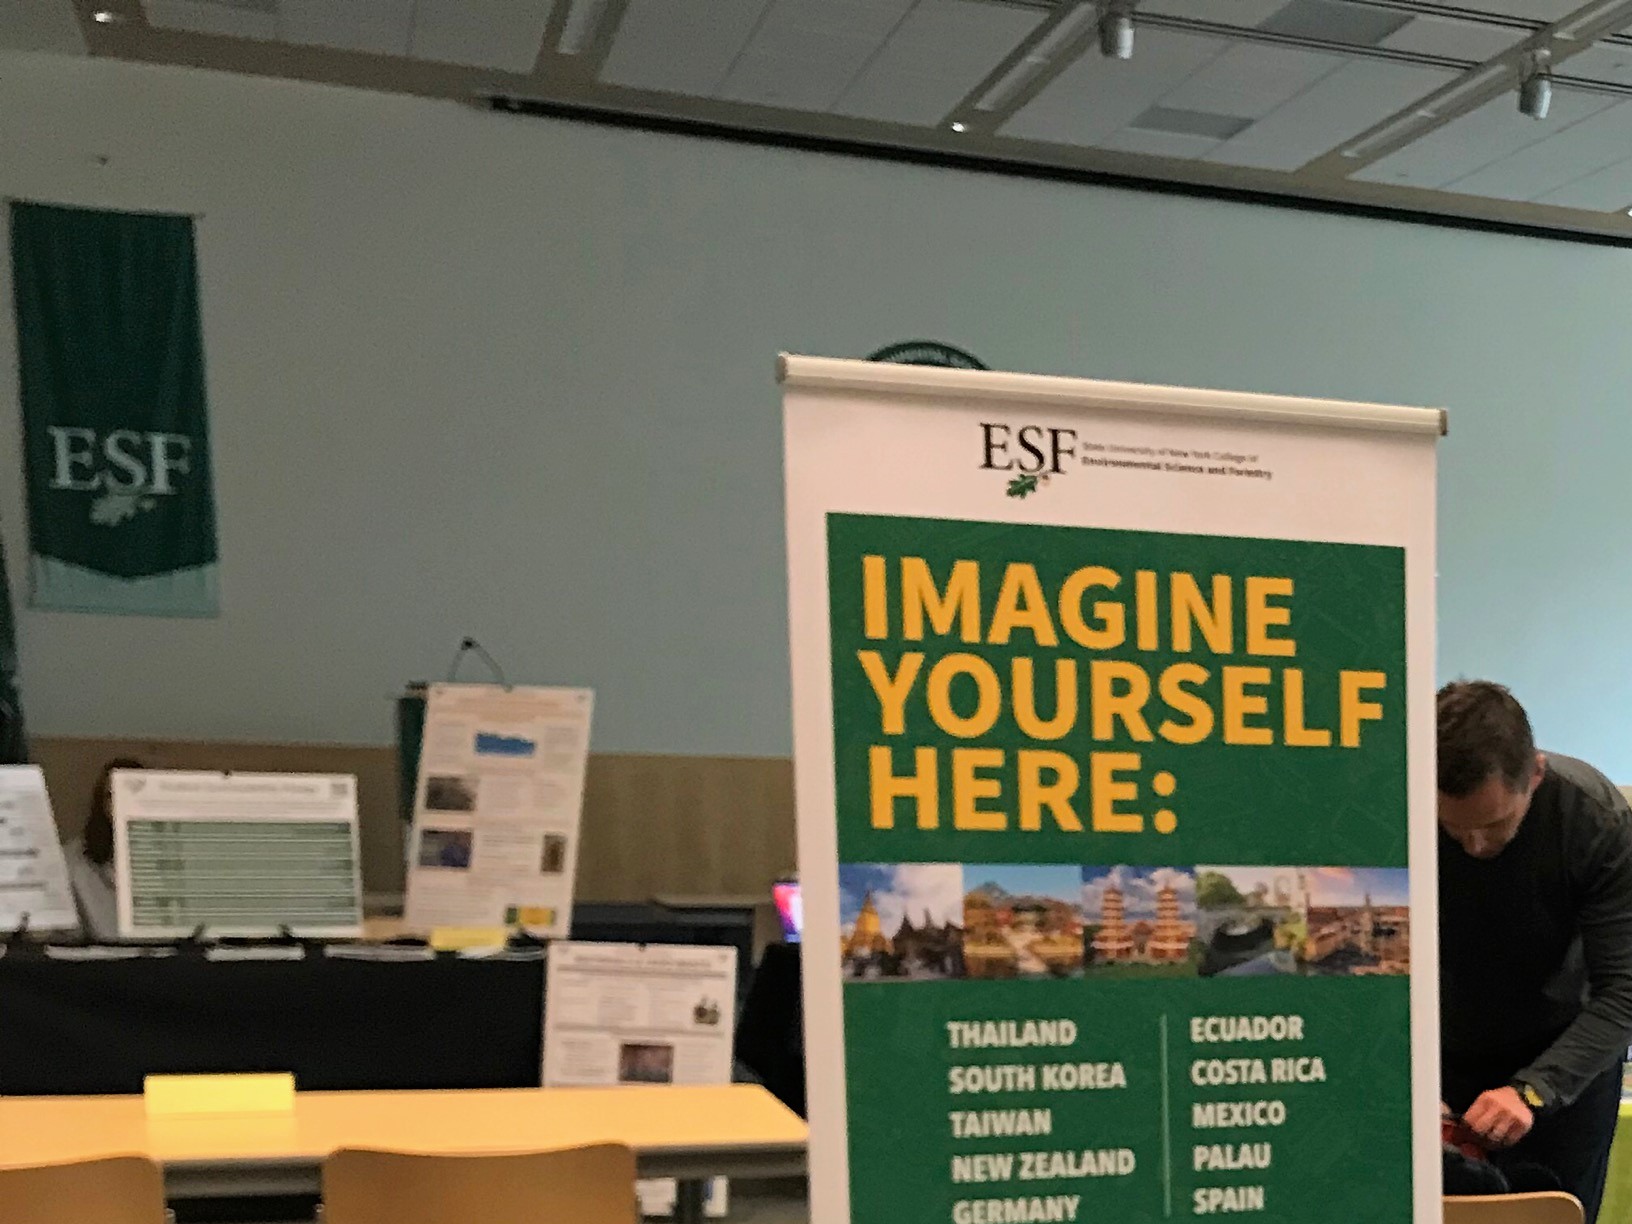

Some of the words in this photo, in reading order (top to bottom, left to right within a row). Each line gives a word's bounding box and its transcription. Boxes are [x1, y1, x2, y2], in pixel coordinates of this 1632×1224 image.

[47, 425, 191, 495] ESF
[979, 422, 1077, 474] ESF
[862, 554, 1296, 657] IMAGINE
[856, 649, 1388, 748] YOURSELF
[868, 745, 1178, 835] HERE:
[946, 1019, 1077, 1048] THAILAND
[1190, 1015, 1304, 1043] ECUADOR
[949, 1064, 1036, 1094] SOUTH
[1042, 1062, 1127, 1090] KOREA
[1191, 1059, 1267, 1086] COSTA
[1272, 1056, 1326, 1083] RICA
[949, 1108, 1052, 1138] TAIWAN
[1192, 1100, 1286, 1129] MEXICO
[951, 1154, 1013, 1183] NEW
[1019, 1148, 1136, 1180] ZEALAND
[1193, 1143, 1272, 1171] PALAU
[1193, 1186, 1265, 1215] SPAIN
